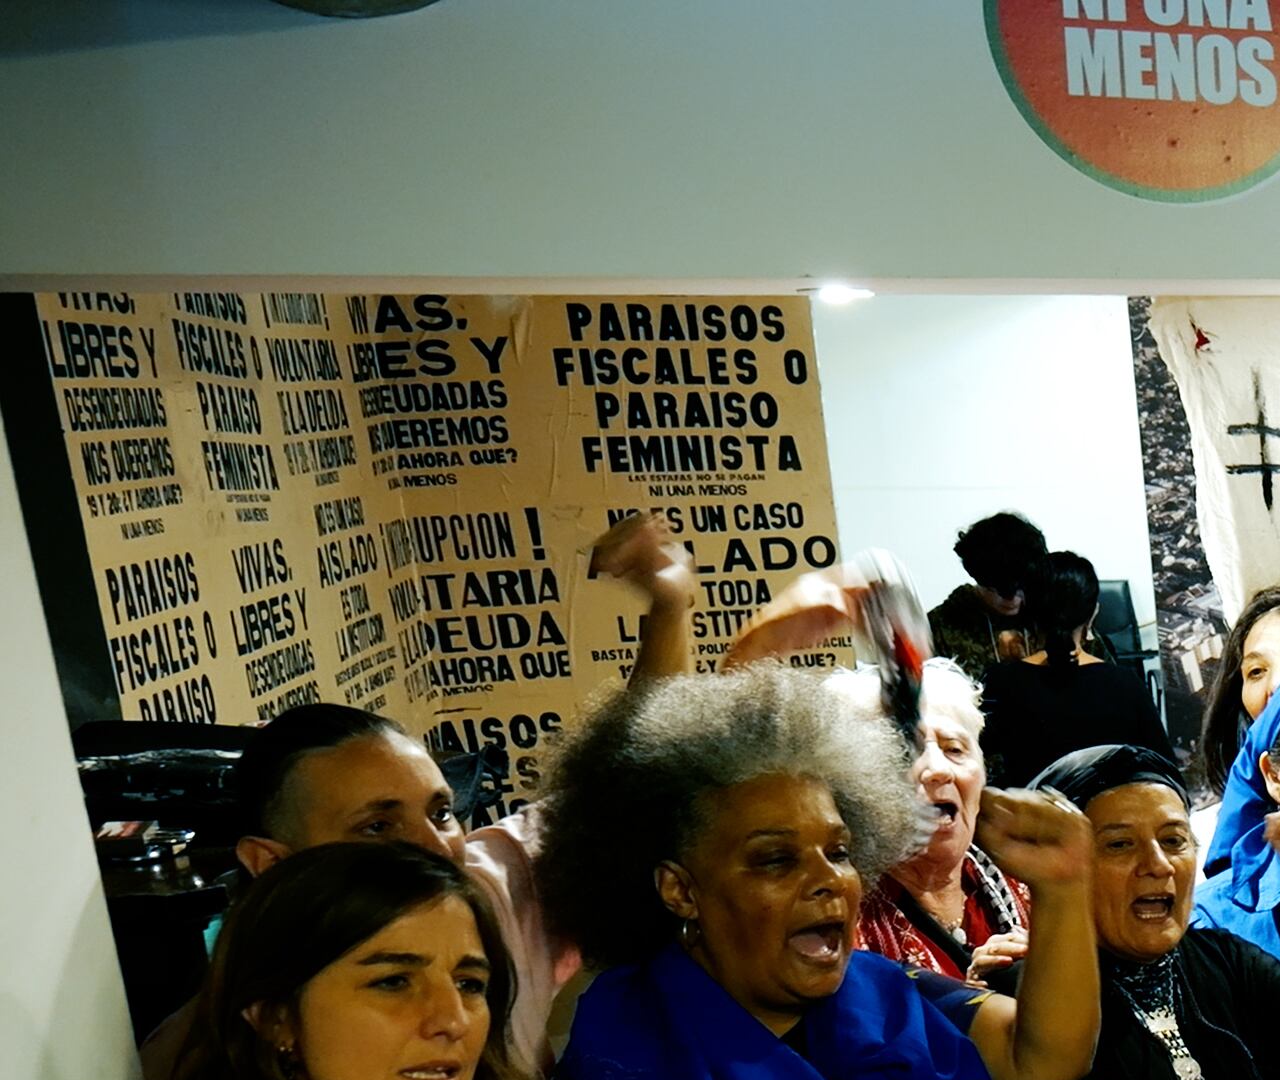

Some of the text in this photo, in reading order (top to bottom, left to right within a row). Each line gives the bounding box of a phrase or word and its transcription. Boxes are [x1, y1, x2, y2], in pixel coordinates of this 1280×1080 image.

[1064, 26, 1278, 107] MENOS
[566, 303, 785, 342] PARAISOS
[43, 320, 158, 379] LIBRES Y
[172, 318, 263, 381] FISCALES O
[469, 336, 509, 374] Y
[552, 347, 808, 386] FISCALES O
[196, 381, 263, 435] PARAISO
[595, 391, 778, 429] PARAISO
[80, 437, 176, 486] NOS QUEREMOS
[201, 441, 281, 491] FEMINISTA
[397, 452, 465, 470] AHORA
[469, 448, 518, 466] QUE?
[582, 435, 803, 473] FEMINISTA
[404, 474, 458, 488] MENOS
[649, 484, 748, 496] NI UNA MENOS
[690, 502, 805, 533] UN CASO
[317, 533, 378, 589] AISLADO
[105, 551, 200, 625] PARAISOS
[701, 578, 772, 608] TODA
[230, 587, 308, 657] LIBRES Y
[109, 610, 217, 695] FISCALES O
[428, 654, 516, 688] AHORA
[592, 647, 634, 661] BASTA
[790, 652, 836, 668] QUE?
